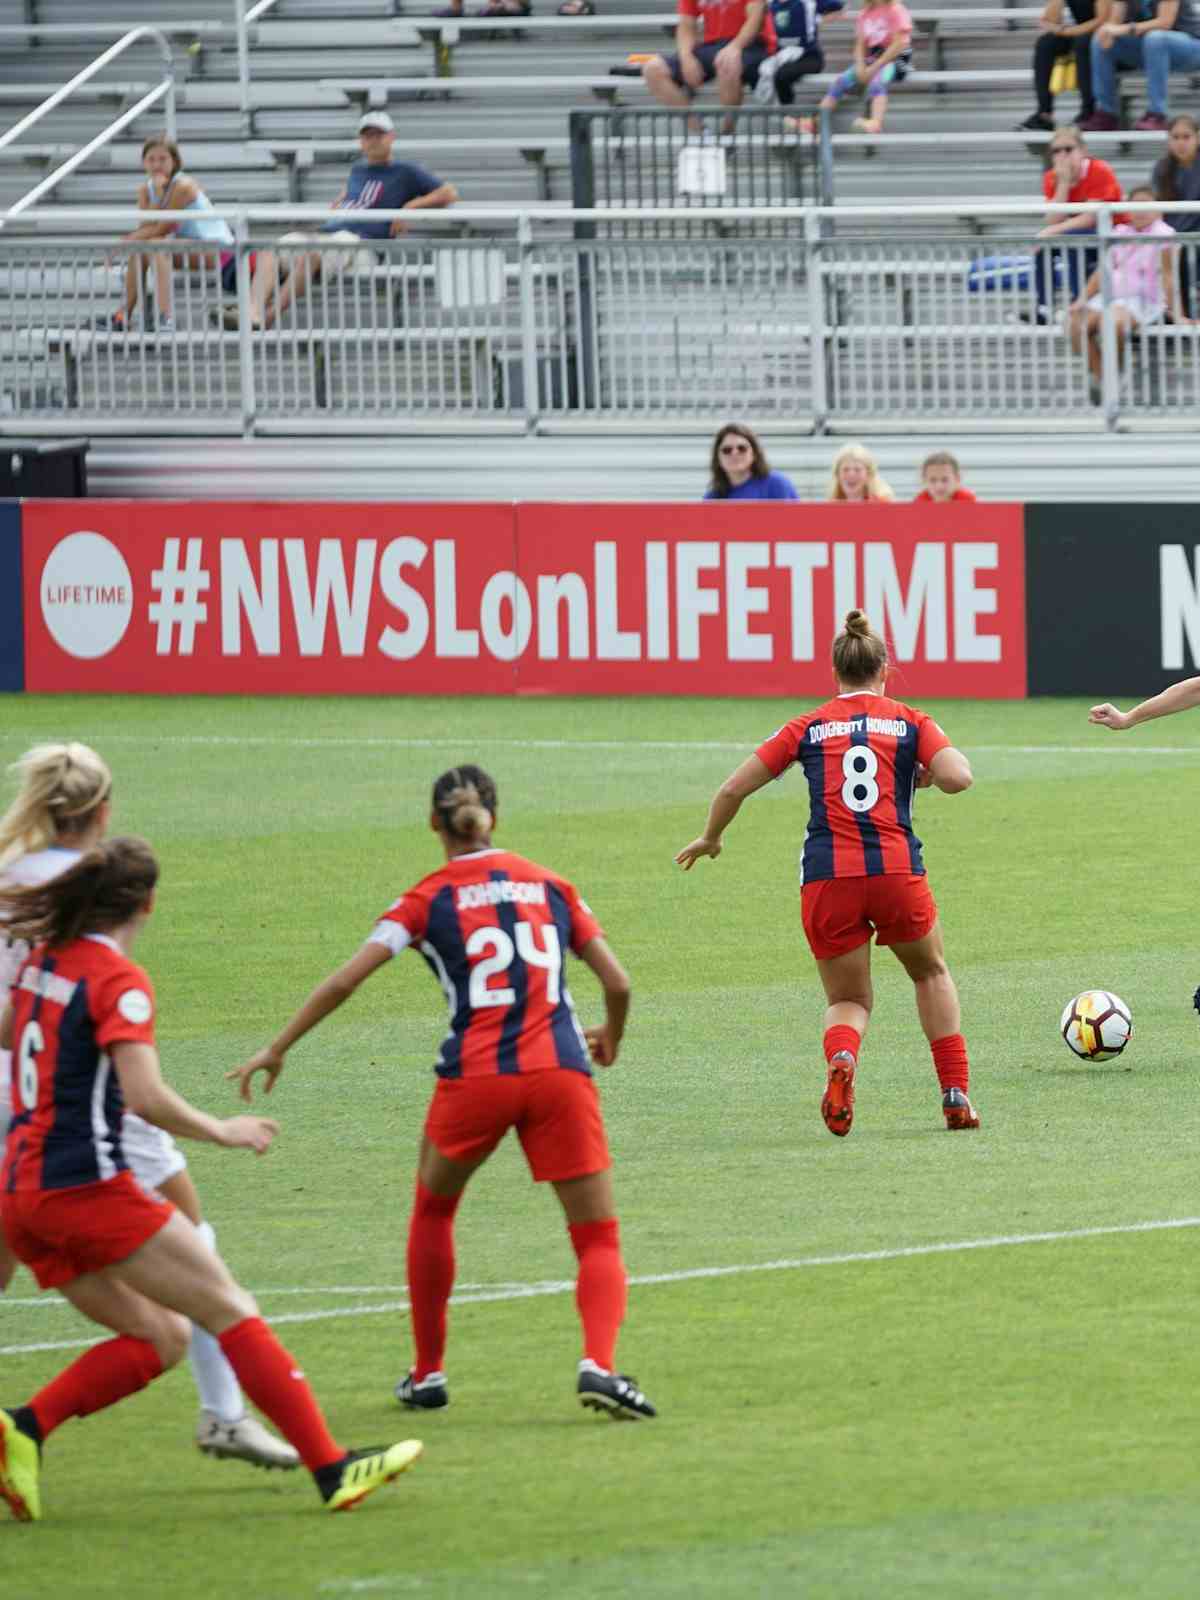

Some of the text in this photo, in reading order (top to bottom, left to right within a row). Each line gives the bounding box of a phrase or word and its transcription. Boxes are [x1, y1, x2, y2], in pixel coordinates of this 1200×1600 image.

[47, 585, 126, 605] LIFETIME
[149, 536, 1001, 662] #NWSLonLIFETIME
[841, 745, 879, 812] 8
[465, 920, 562, 1009] 24
[19, 1020, 45, 1111] 6
